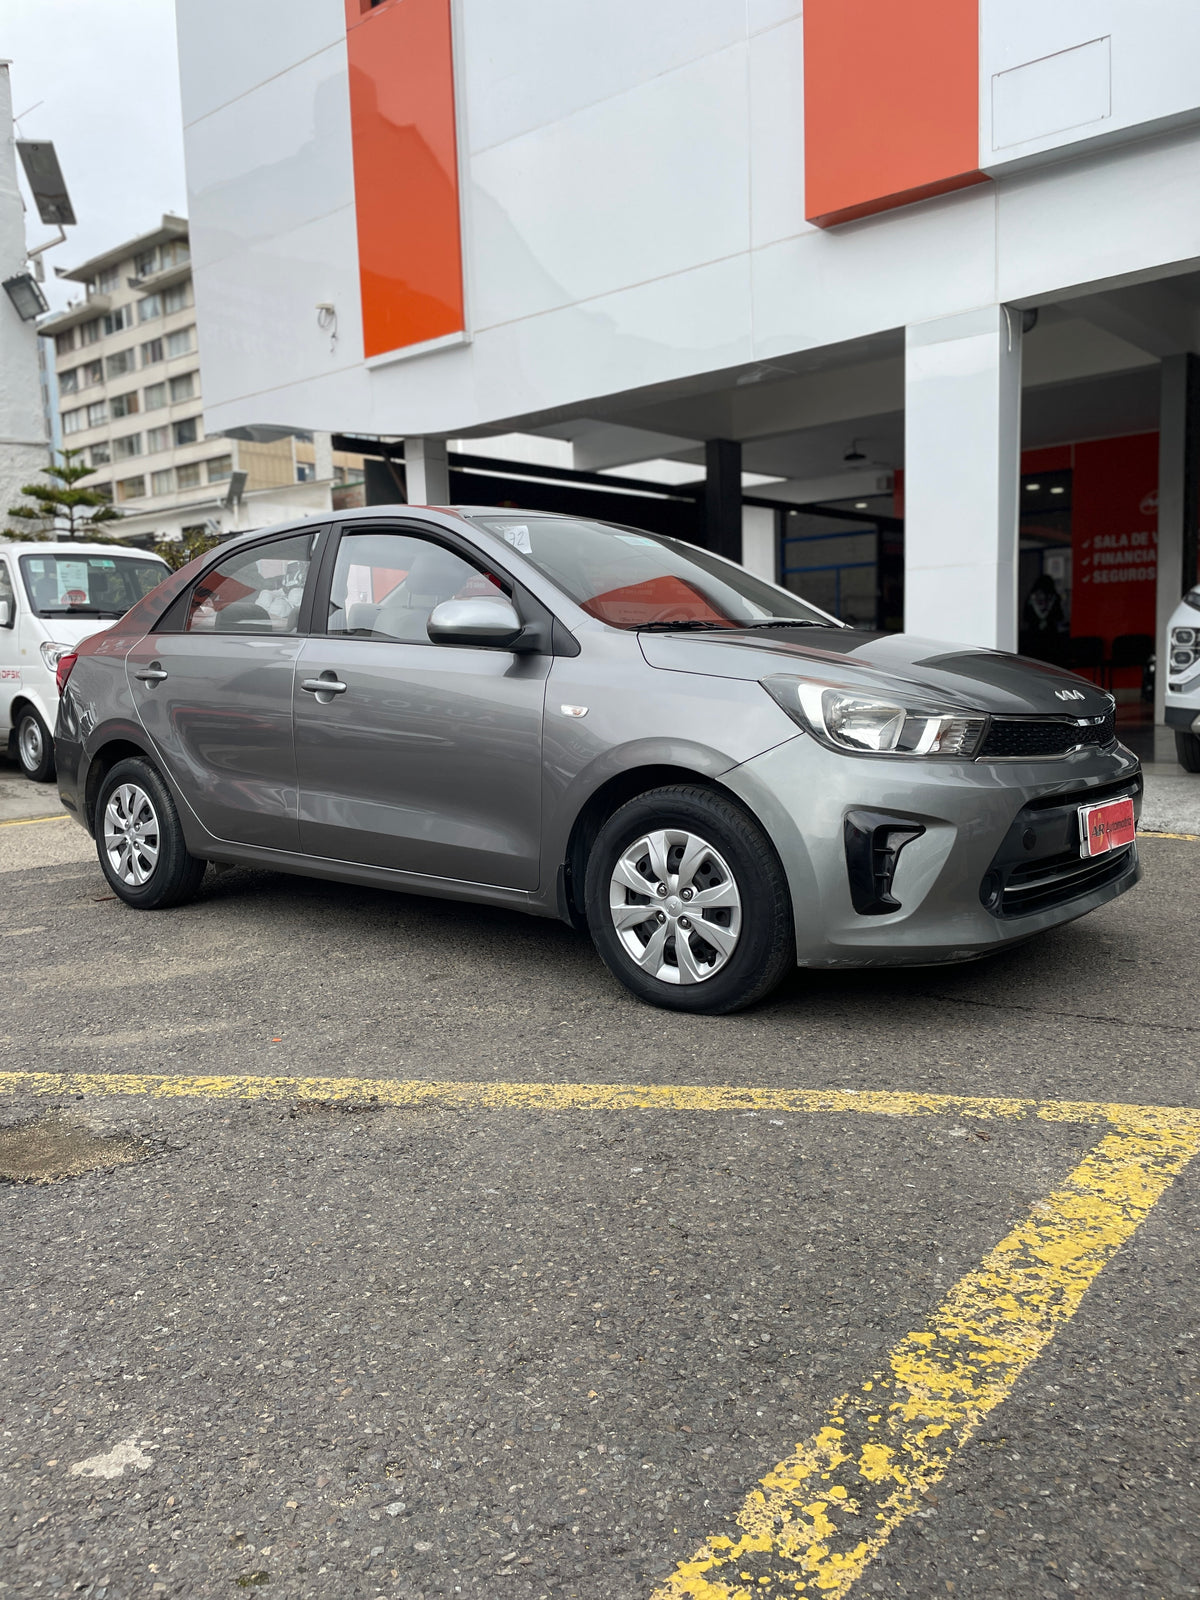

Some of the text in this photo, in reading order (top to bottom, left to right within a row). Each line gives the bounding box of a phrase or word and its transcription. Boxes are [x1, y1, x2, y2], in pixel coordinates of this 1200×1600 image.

[1093, 534, 1128, 549] SALA
[1131, 532, 1149, 546] DE
[1094, 566, 1156, 583] SEGUROS
